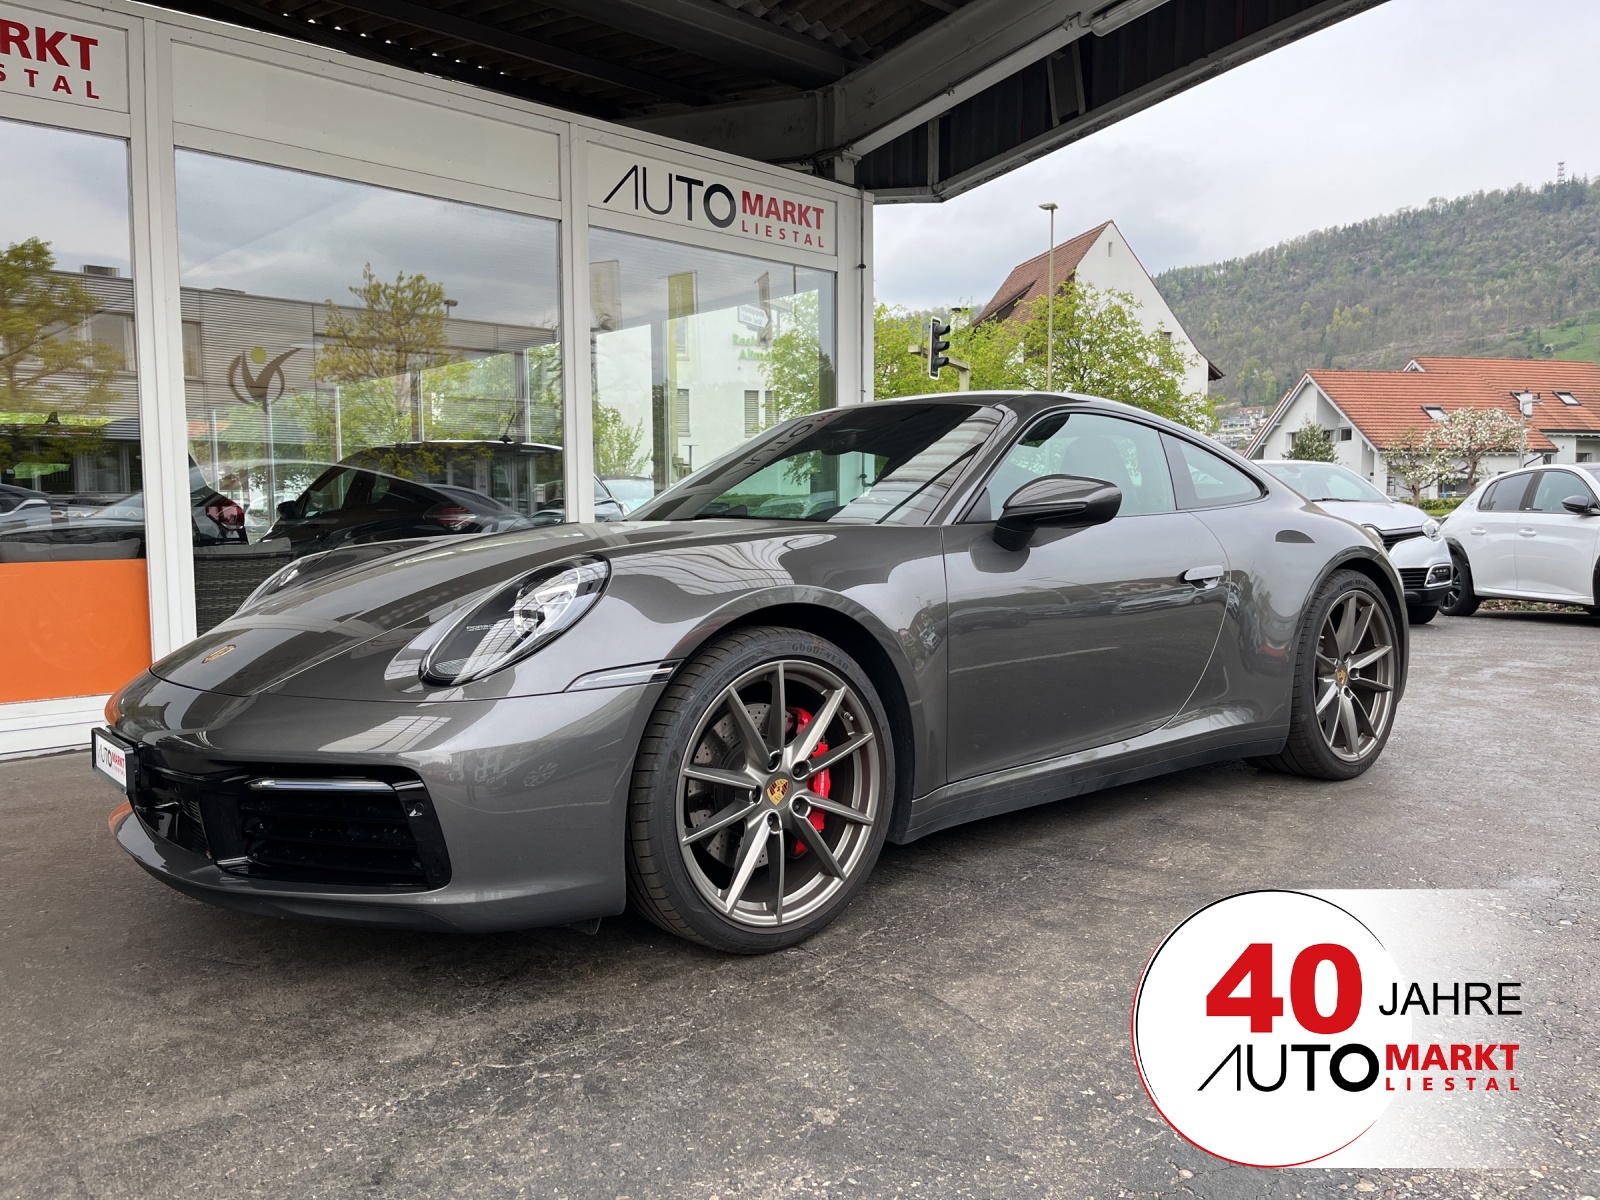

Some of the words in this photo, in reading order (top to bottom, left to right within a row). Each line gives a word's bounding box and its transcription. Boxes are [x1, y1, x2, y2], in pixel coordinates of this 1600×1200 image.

[603, 164, 737, 229] AUTO
[742, 190, 825, 230] MARKT
[742, 219, 825, 249] LIESTAL
